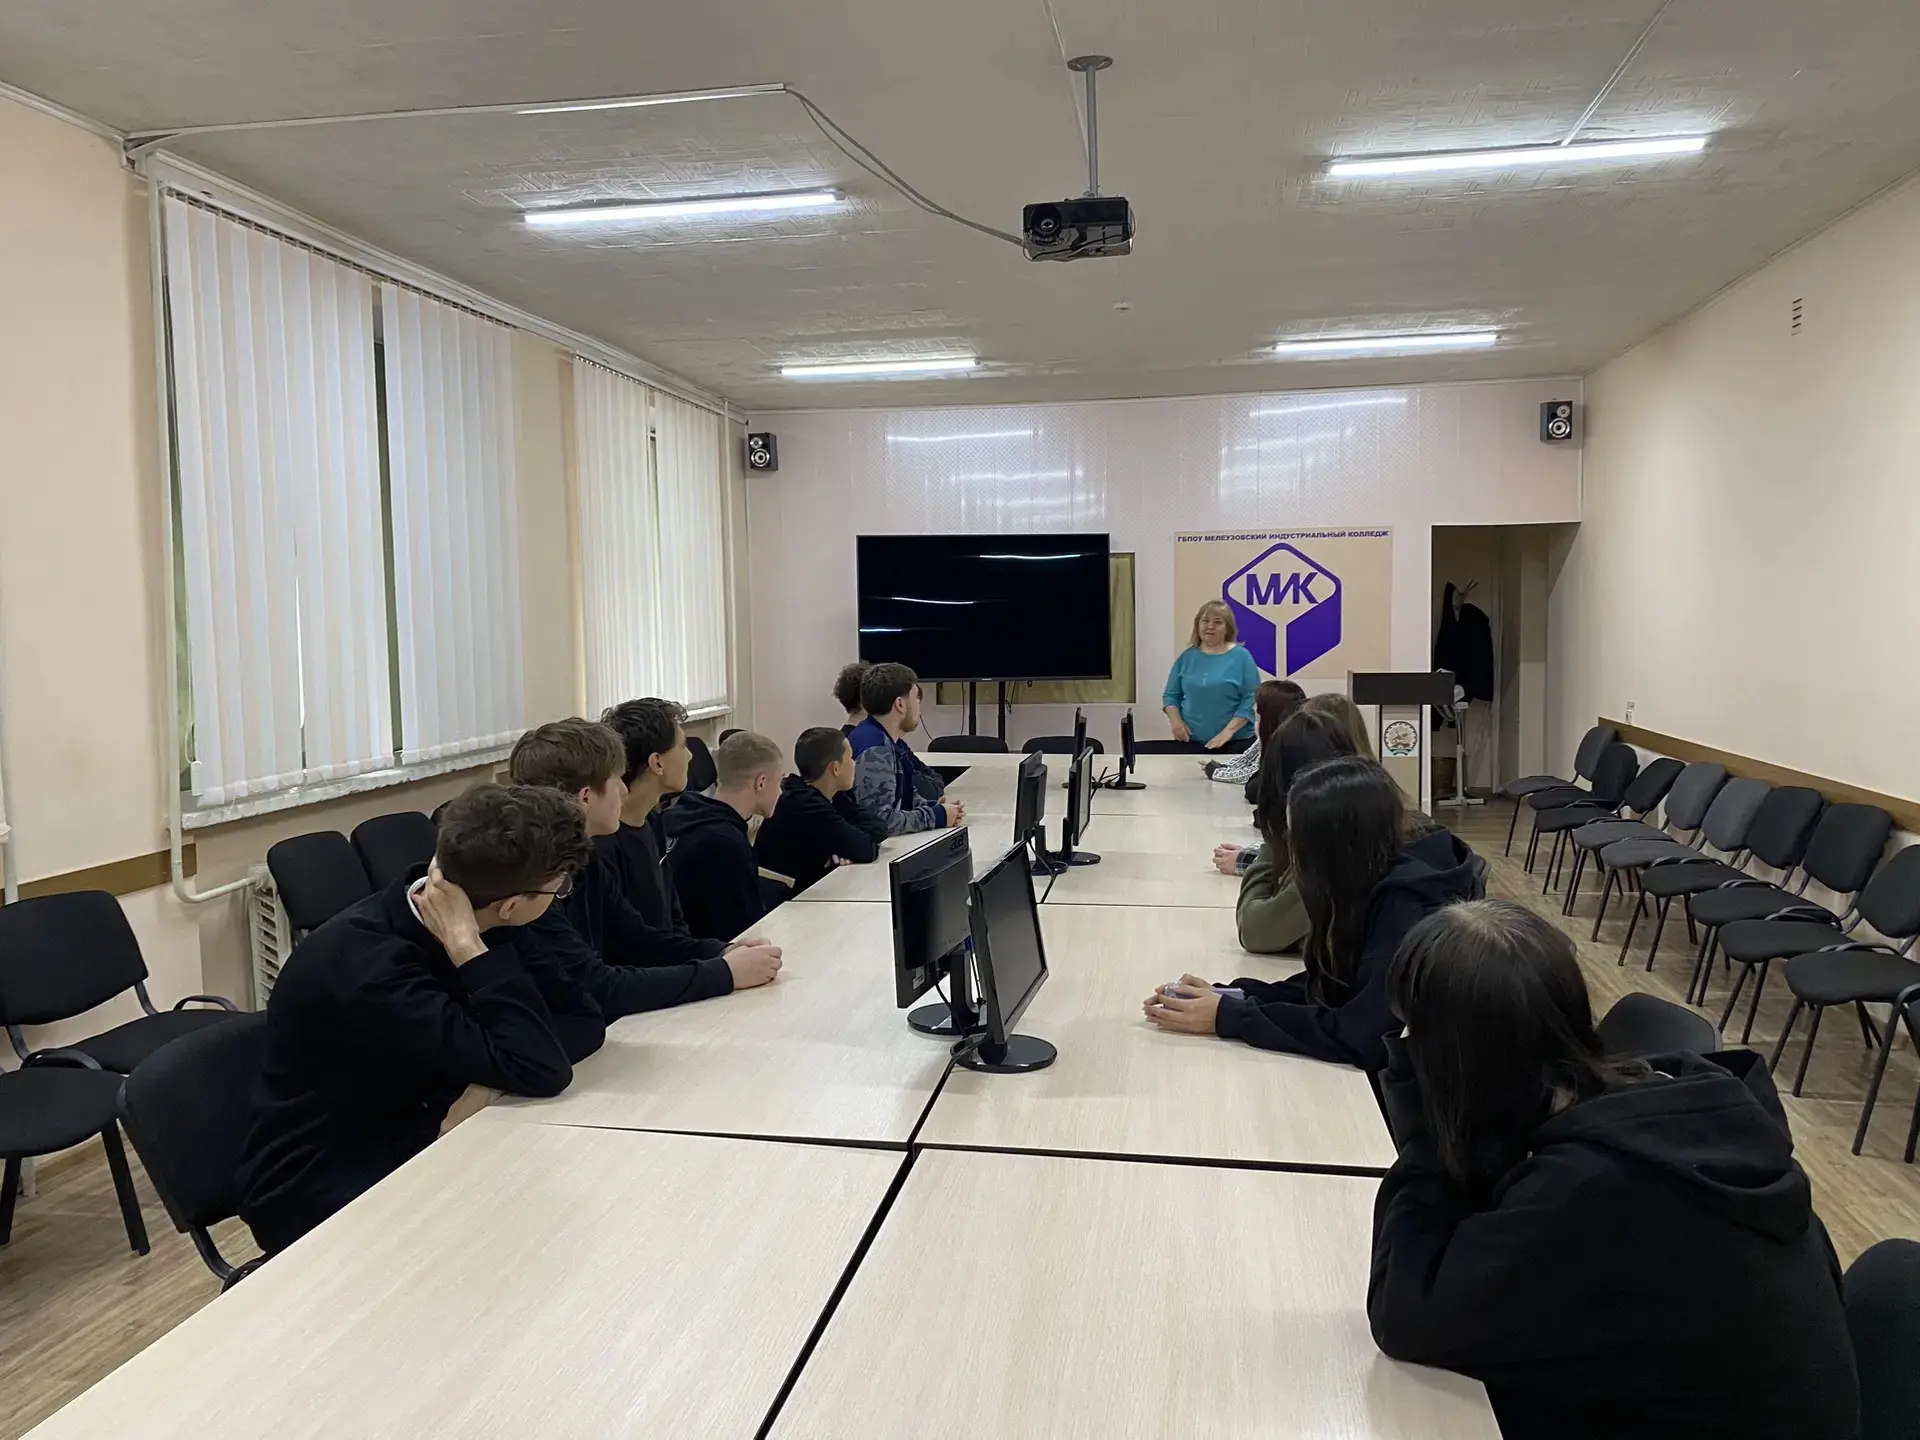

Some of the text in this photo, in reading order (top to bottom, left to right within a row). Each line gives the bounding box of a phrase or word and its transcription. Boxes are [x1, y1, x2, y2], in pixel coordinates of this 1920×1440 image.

[1204, 533, 1267, 541] МЕЛЕУЗОВСКИЙ
[1269, 531, 1346, 540] ИНДУСТРИАЛЬНЫЙ
[1348, 530, 1389, 538] КОЛЛЕДЖ
[1246, 571, 1319, 606] МИК
